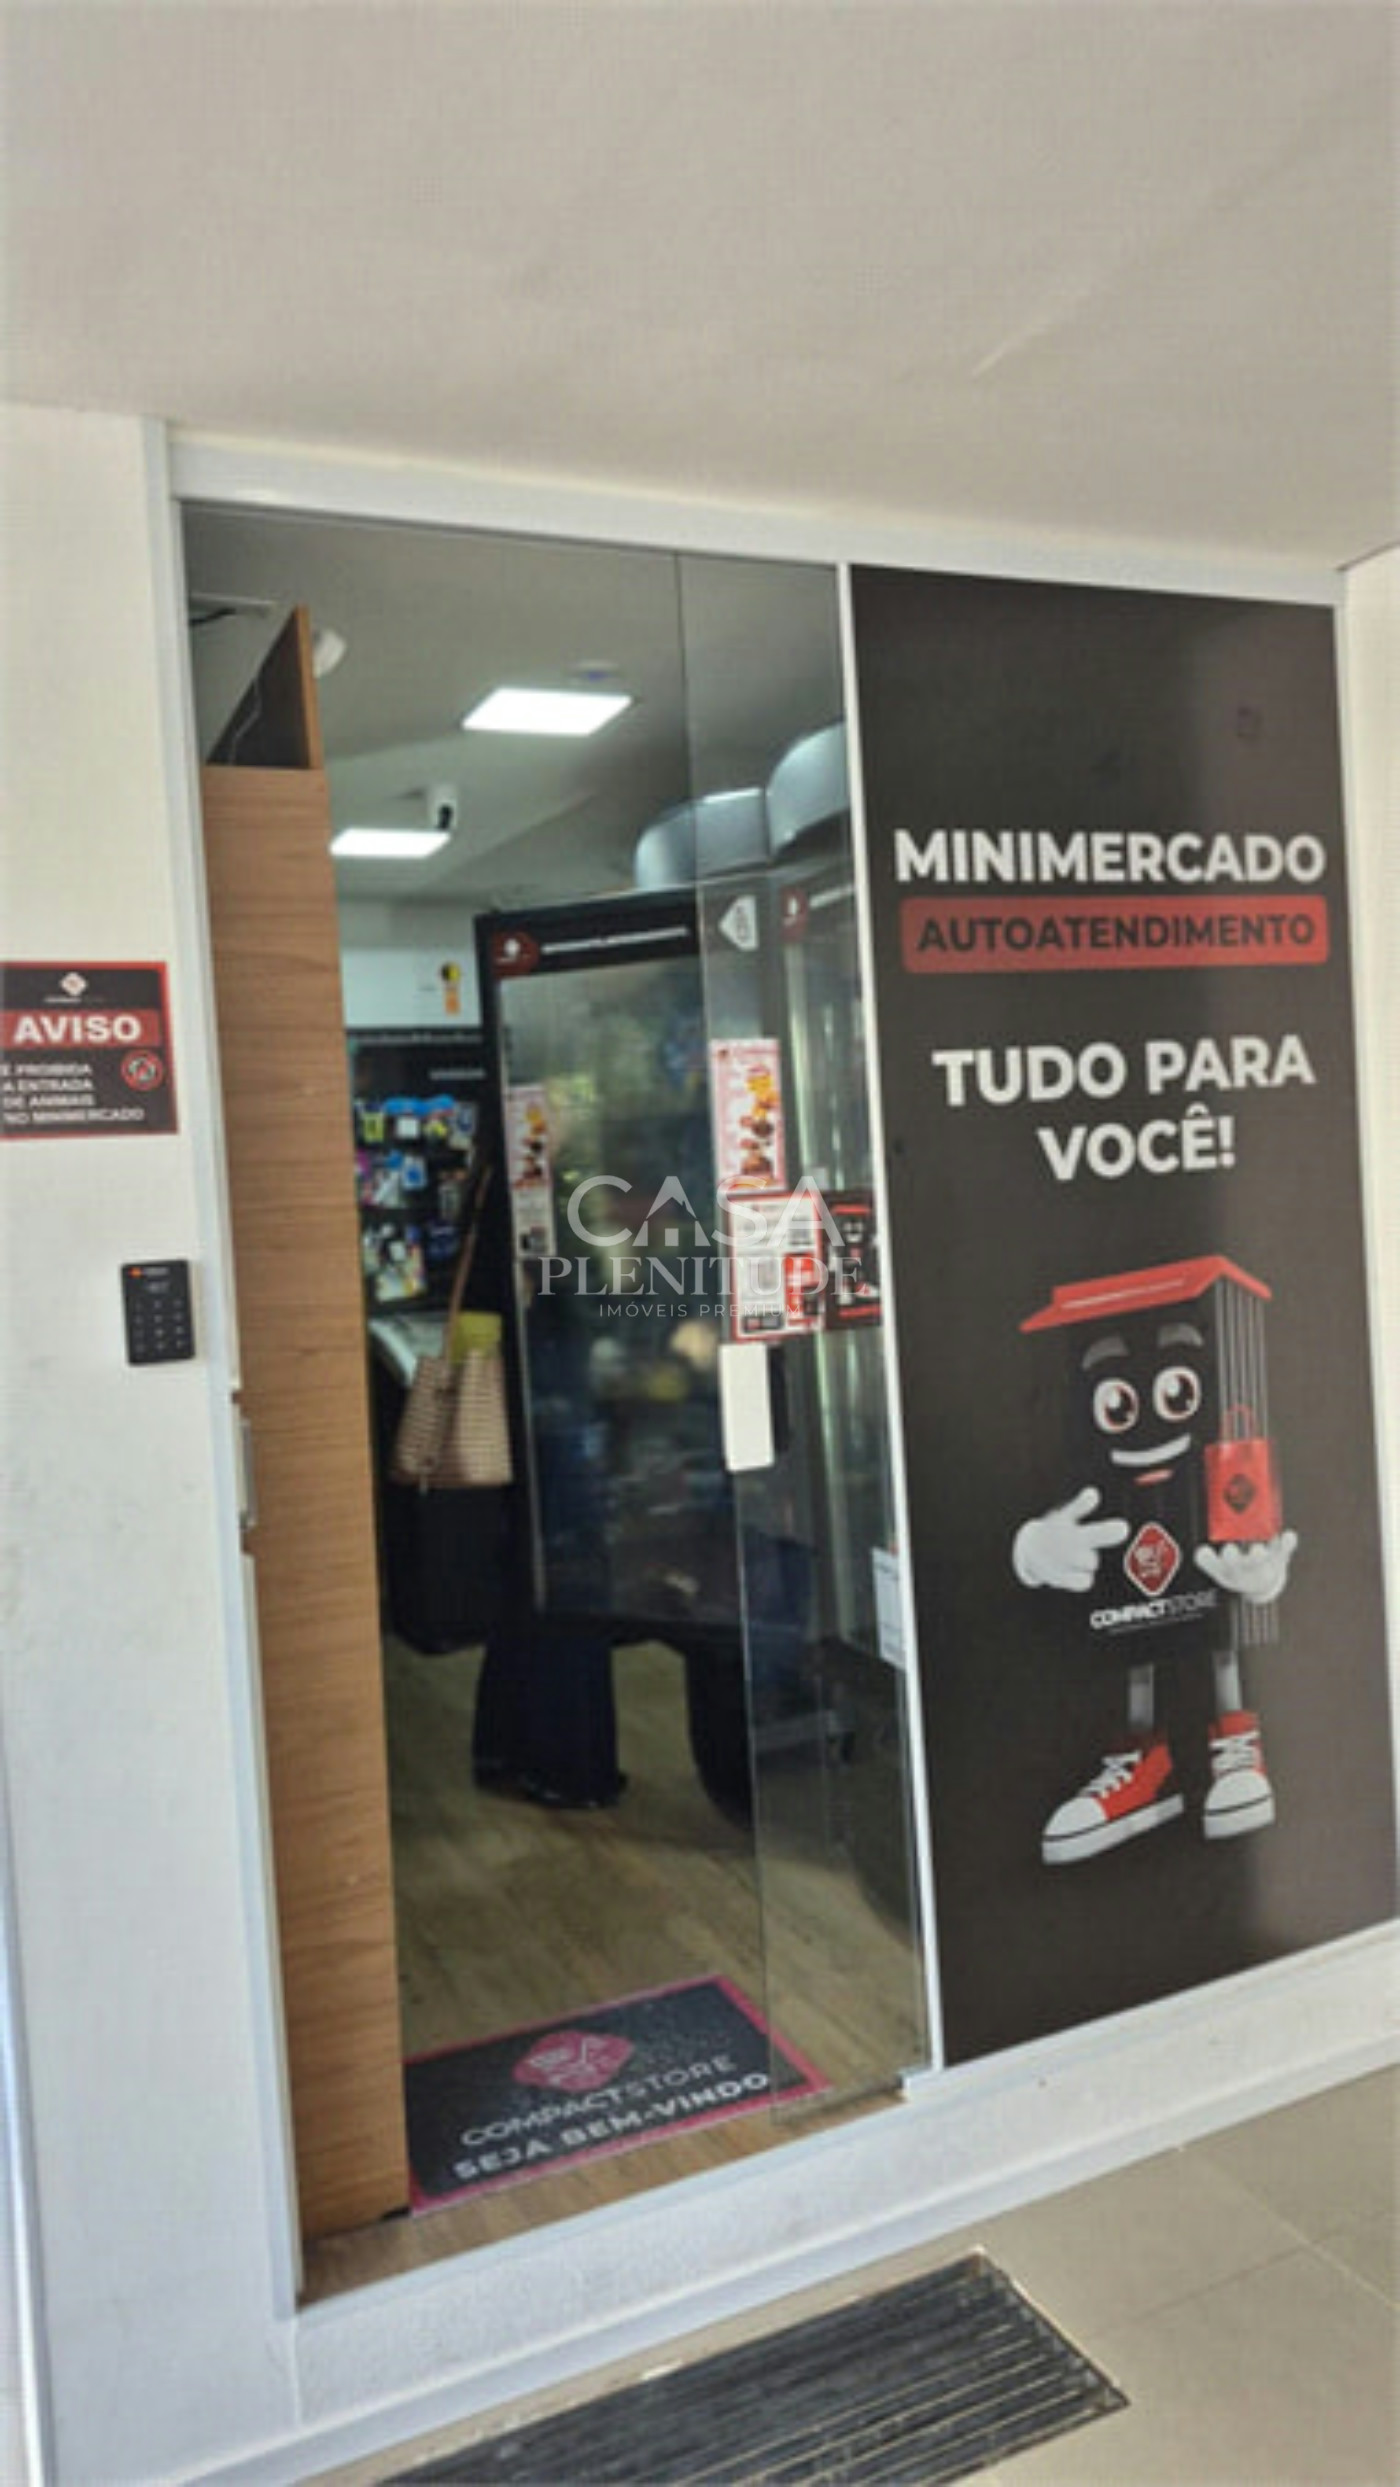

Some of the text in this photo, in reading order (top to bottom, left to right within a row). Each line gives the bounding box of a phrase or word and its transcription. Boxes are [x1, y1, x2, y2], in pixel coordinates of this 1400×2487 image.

[894, 828, 1326, 883] MINIMERCADO
[917, 914, 1316, 952] AUTOATENDIMENTO
[13, 1014, 142, 1043] AVISO
[3, 1078, 95, 1092] A ENTRADA
[932, 1033, 1317, 1107] TUDO PARA
[3, 1112, 30, 1125] NO
[1036, 1102, 1237, 1182] VOCÊ!
[453, 2072, 770, 2180] SEJA BEM-VINDO
[461, 2055, 738, 2146] COMPACTSTORE
